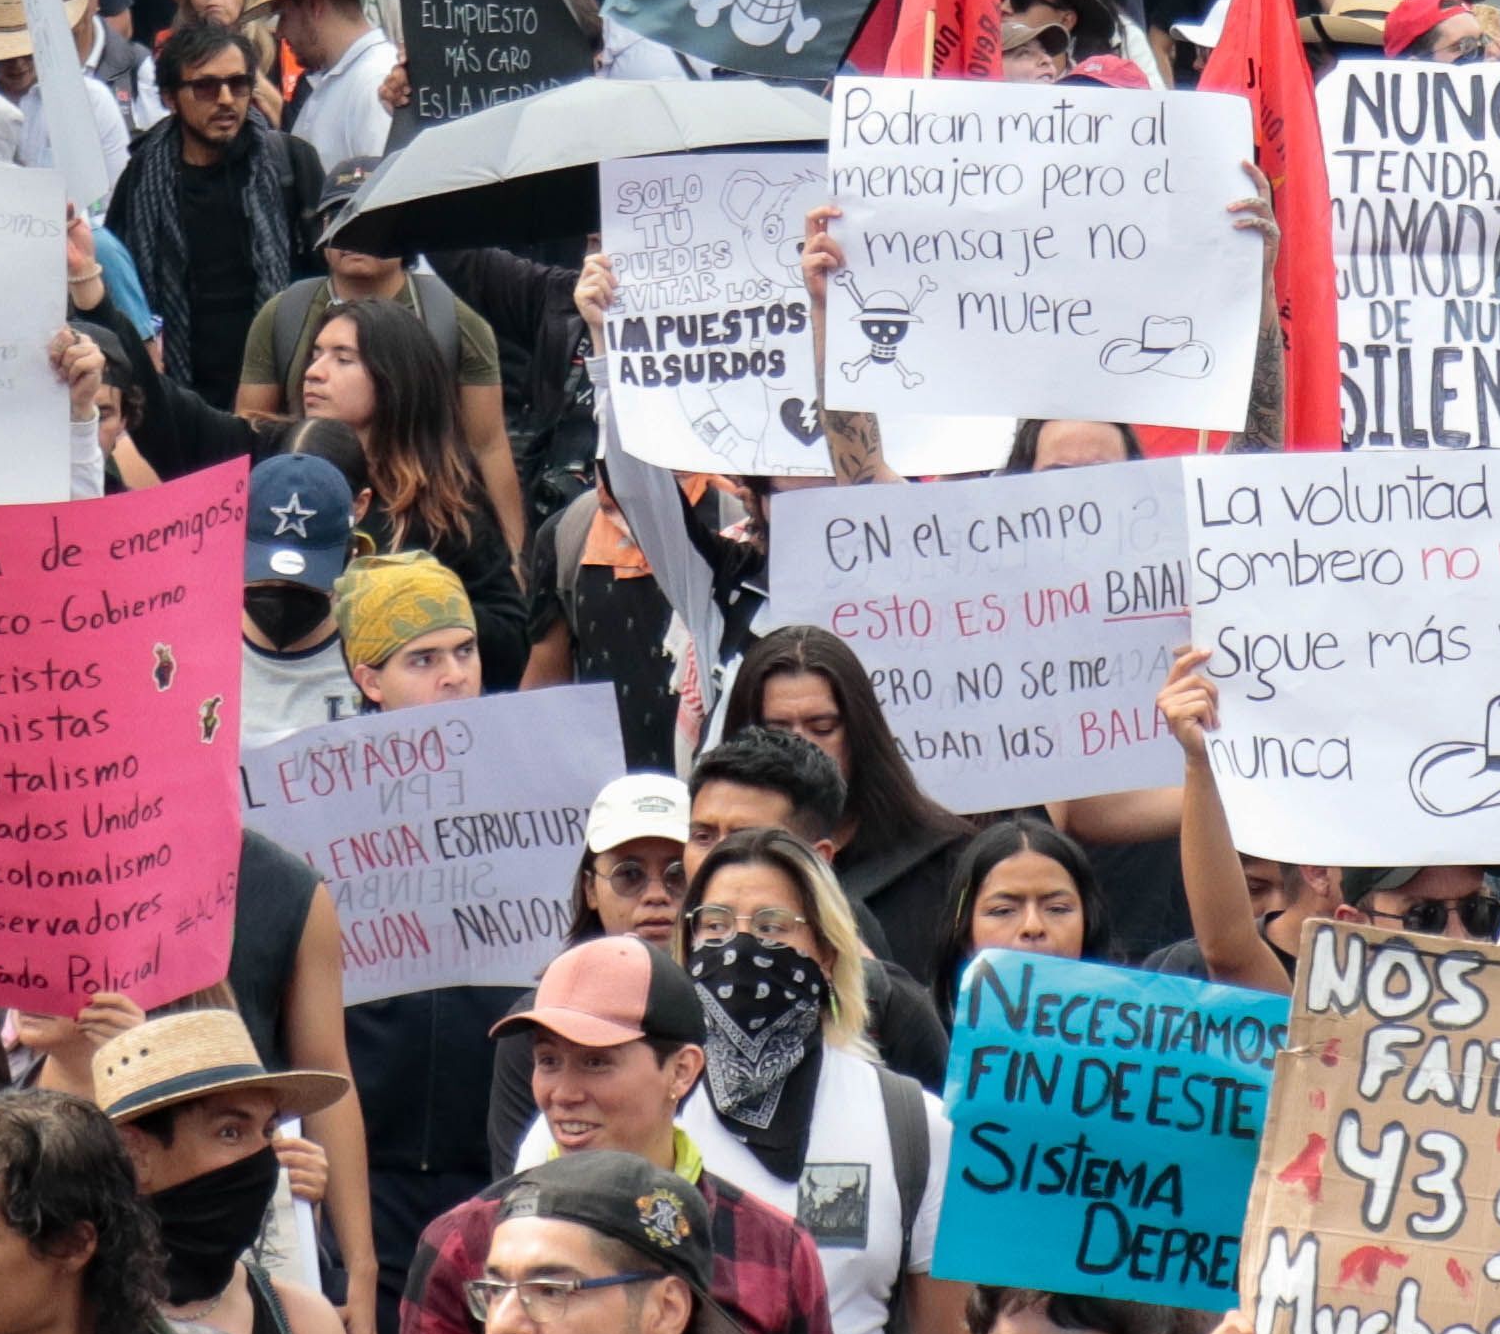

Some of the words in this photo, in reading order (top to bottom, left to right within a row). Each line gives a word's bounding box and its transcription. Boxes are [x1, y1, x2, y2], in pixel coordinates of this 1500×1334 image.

[421, 2, 445, 29] EL
[444, 4, 539, 36] IMPUESTO
[445, 43, 483, 77] MÁS
[487, 46, 532, 72] CARO
[842, 86, 983, 149] Podran
[998, 98, 1114, 146] matar
[1131, 100, 1167, 146] al
[616, 174, 703, 216] SOLO
[831, 157, 1024, 208] mensajero
[1042, 162, 1125, 209] pero
[1143, 163, 1175, 196] el
[634, 203, 694, 250] TÚ
[863, 222, 1061, 277] mensaje
[1087, 221, 1147, 261] no
[725, 276, 775, 304] LOS
[956, 288, 1100, 337] muere
[607, 300, 808, 354] IMPUESTOS
[1371, 299, 1414, 343] DE
[620, 350, 787, 388] ABSURDOS
[1196, 476, 1262, 528] La
[1280, 464, 1494, 526] voluntad
[40, 514, 83, 573] de
[1196, 538, 1405, 606] Sombrero
[1421, 544, 1481, 582] no
[830, 592, 933, 641] esto
[956, 662, 1003, 703] NO
[1205, 625, 1346, 703] Sigue
[1368, 614, 1473, 668] más
[1000, 722, 1055, 762] las
[1206, 736, 1354, 782] nunca
[82, 791, 165, 842] Unidos
[66, 931, 162, 996] Policial
[1305, 924, 1491, 1030] NOS
[967, 957, 1289, 1070] NECESITAMOS
[965, 1044, 1063, 1106] FIN
[1071, 1057, 1141, 1124] DE
[1146, 1065, 1266, 1141] ESTE
[962, 1121, 1184, 1218] SISTEMA
[1334, 1107, 1467, 1243] 43
